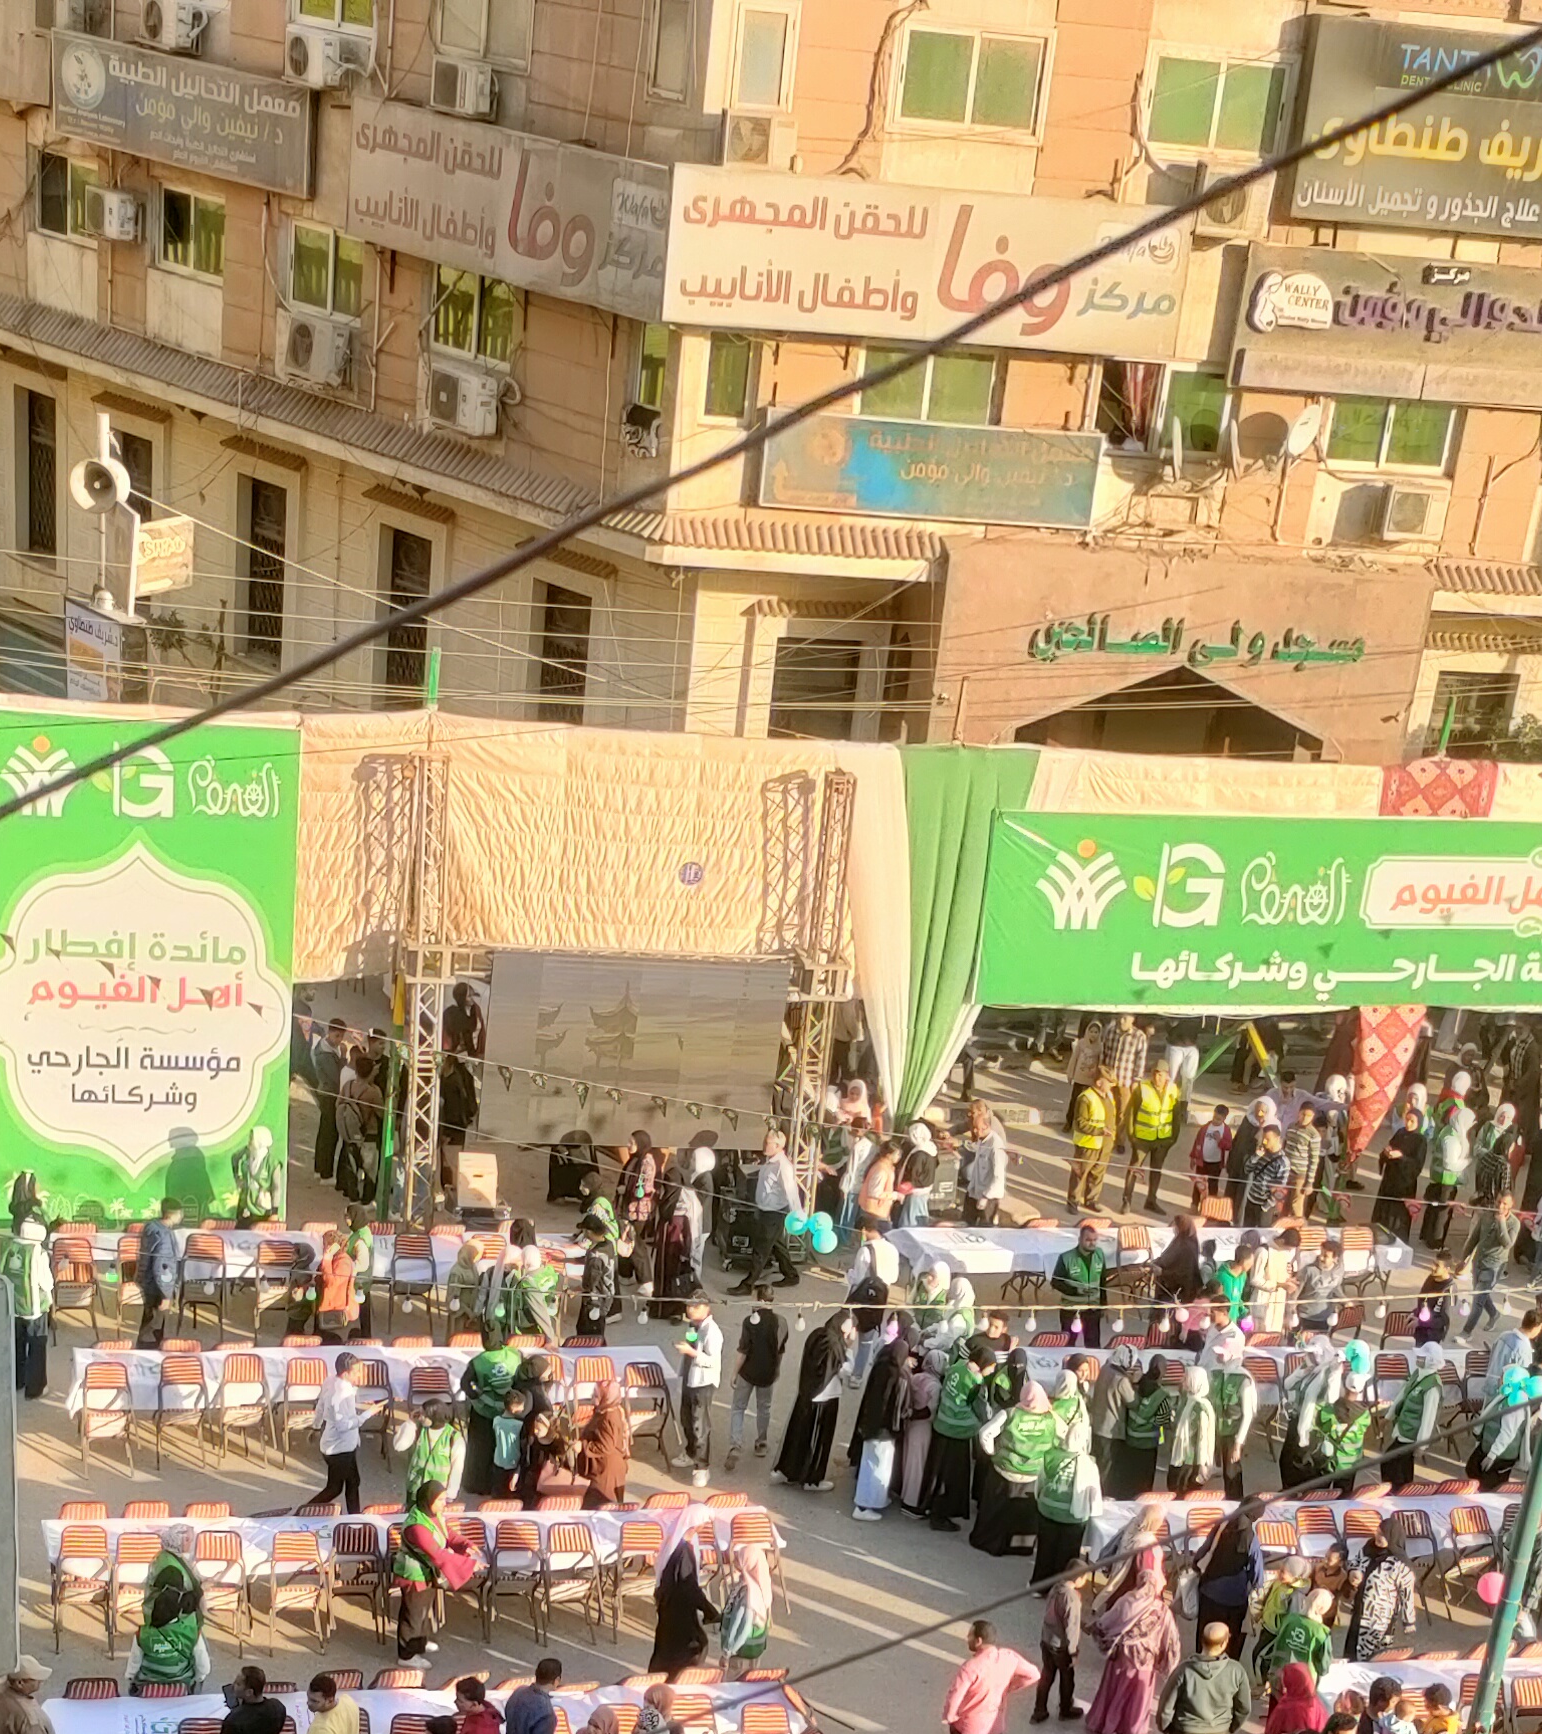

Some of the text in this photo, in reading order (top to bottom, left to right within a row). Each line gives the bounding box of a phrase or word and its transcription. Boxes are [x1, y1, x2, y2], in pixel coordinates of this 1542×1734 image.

[109, 54, 300, 118] معمل التحاليل الطبية
[135, 93, 259, 143] نيفين مؤمن
[444, 138, 503, 180] للحقن
[355, 187, 496, 259] وأطفال الأنابيب
[509, 150, 595, 287] وفا
[834, 204, 928, 239] للحقن
[1297, 178, 1539, 228] علاج الجذور تجميل الأسنان
[599, 232, 664, 280] مركز
[937, 205, 1176, 336] مركز وفا
[1429, 264, 1472, 285] مركز
[680, 259, 919, 320] وأطفال الأنابيب
[1285, 282, 1321, 296] WALLY
[1288, 295, 1329, 311] CENTER
[899, 459, 949, 481] مؤمن
[1390, 871, 1504, 915] الفيوم
[23, 928, 246, 972] مائدة إفطار
[27, 974, 243, 1013] أهل الفيوم
[1131, 950, 1514, 1000] الجارحي وشركائها
[27, 1044, 241, 1077] مؤسسة الجارحي
[71, 1082, 197, 1112] وشركائها
